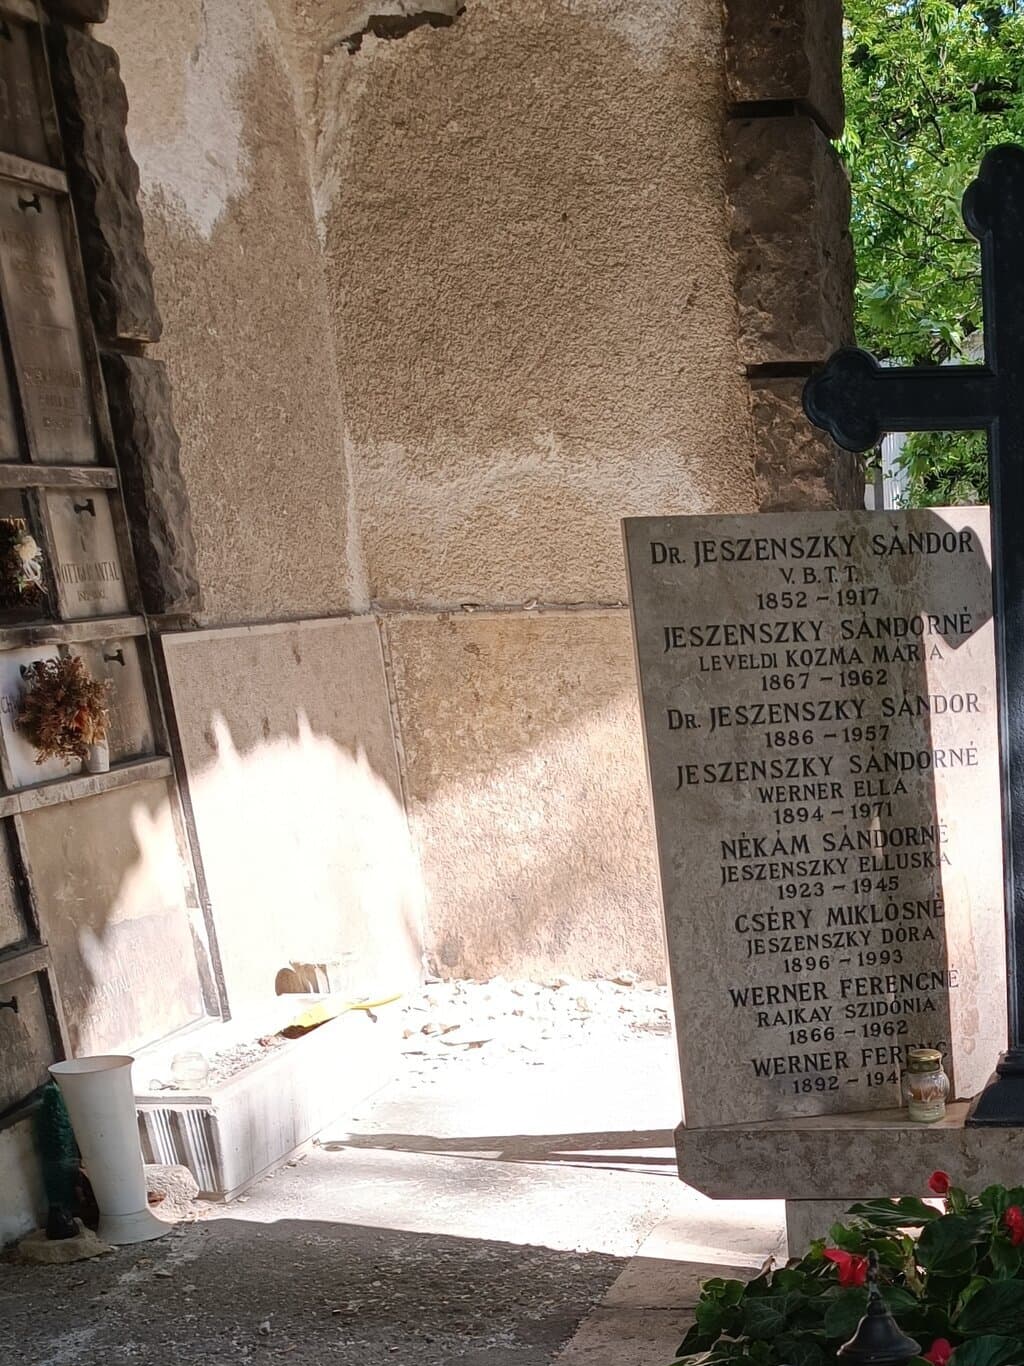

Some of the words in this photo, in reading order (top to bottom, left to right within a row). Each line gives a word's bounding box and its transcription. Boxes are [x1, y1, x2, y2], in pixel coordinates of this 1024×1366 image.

[694, 535, 856, 568] JESZENSZKY
[872, 526, 974, 557] SÁNDOR
[757, 591, 808, 610] 1852
[836, 588, 880, 607] 1917
[663, 620, 824, 653] JESZENSZKY
[841, 606, 973, 640] SÁNDORNÉ
[700, 652, 777, 672] LEVELDI
[786, 646, 863, 667] KOZMA
[761, 673, 809, 692] 1867
[839, 669, 888, 687] 1962
[710, 699, 866, 732] JESZENSZKY
[882, 690, 981, 718] SÁNDOR
[764, 728, 814, 748] 1886
[843, 725, 890, 743] 1957
[676, 756, 834, 790] JESZENSZKY
[850, 741, 979, 775] SÁNDORNÉ
[758, 782, 844, 804] WERNER
[855, 778, 909, 797] ELLA
[774, 806, 824, 825] 1894
[851, 802, 894, 820] 1971
[720, 830, 811, 860] NÉKÁM
[823, 819, 949, 852] SÁNDORNÉ
[720, 858, 849, 887] JESZENSZKY
[859, 852, 953, 873] ELLUSKA
[777, 881, 825, 901] 1923
[854, 876, 899, 895] 1945
[735, 906, 813, 934] CSÉRY
[827, 893, 945, 928] MIKLÓSNÉ
[747, 930, 873, 959] JESZENSZKY
[882, 923, 936, 946] DÓRA
[784, 955, 830, 973] 1896
[858, 949, 904, 967] 1993
[729, 981, 827, 1008] WERNER
[840, 964, 960, 999] FERENCNÉ
[757, 1006, 833, 1029] RAJKAY
[845, 997, 937, 1020] SZIDÓNIA
[789, 1027, 835, 1045] 1866
[862, 1021, 908, 1038] 1962
[751, 1051, 849, 1077] WERNER
[793, 1076, 840, 1094] 1892
